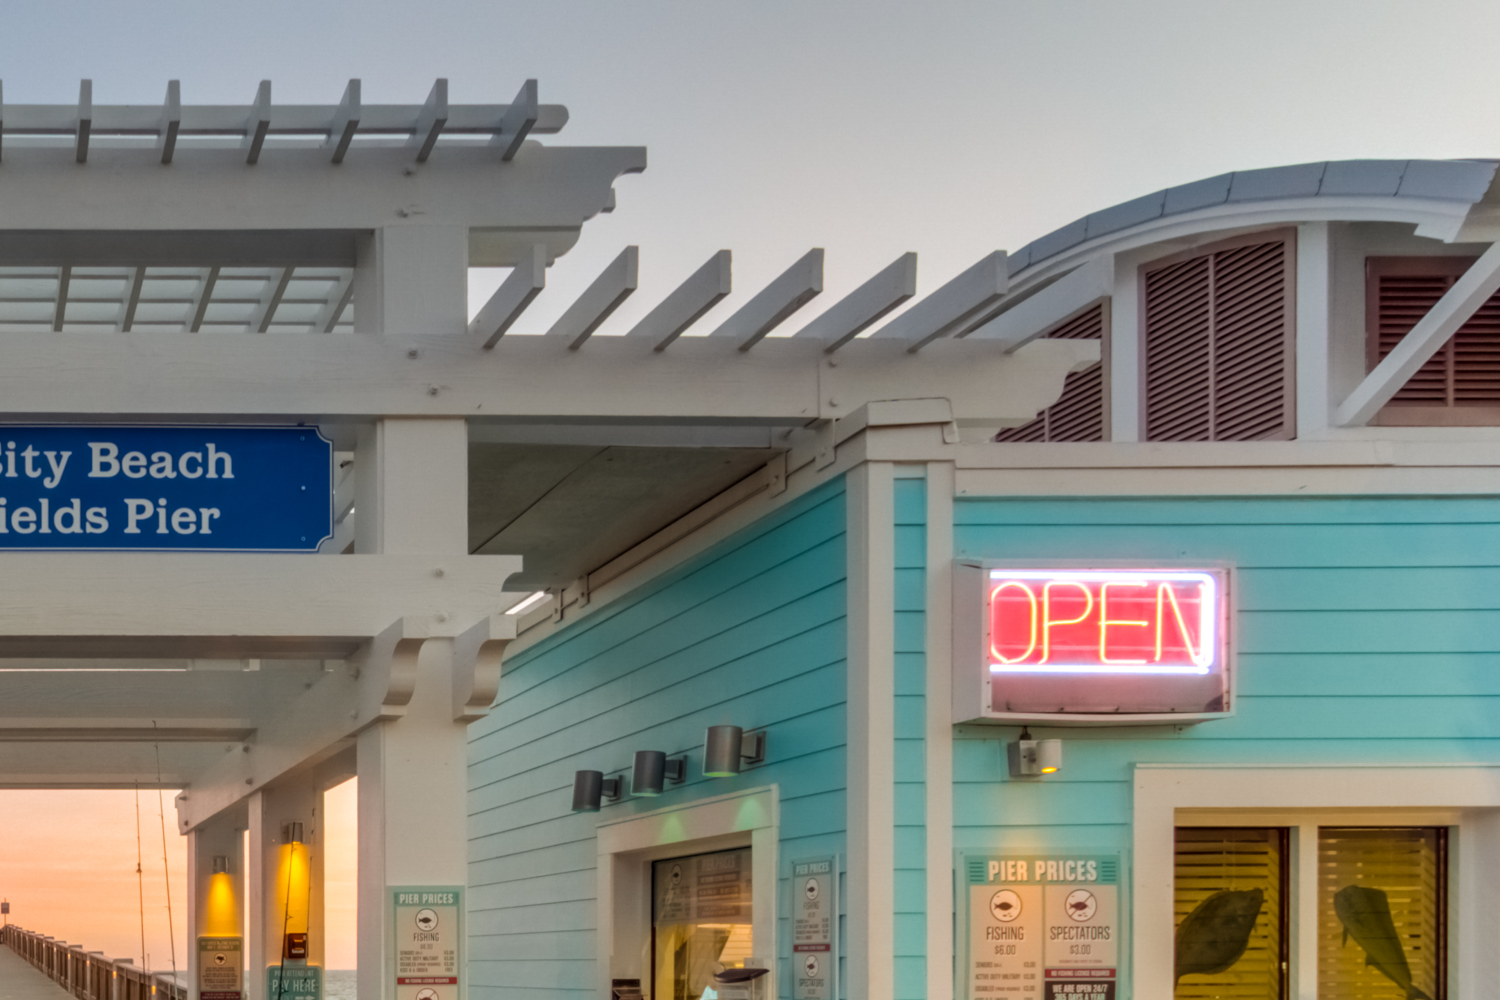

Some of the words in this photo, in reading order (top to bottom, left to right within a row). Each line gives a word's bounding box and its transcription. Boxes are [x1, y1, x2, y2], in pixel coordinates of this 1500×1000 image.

[88, 443, 235, 479] Beach
[124, 499, 221, 535] Pier
[990, 581, 1208, 666] OPEN
[796, 864, 808, 874] PIER
[810, 862, 829, 873] PRICES
[988, 860, 1028, 882] PIER
[1035, 860, 1097, 881] PRICES
[400, 894, 419, 904] PIER
[423, 894, 453, 904] PRICES
[414, 933, 439, 941] FISHING
[986, 926, 1024, 940] FISHING
[1050, 926, 1110, 940] SPECTATORS
[995, 945, 1016, 955] $6.00
[1070, 945, 1090, 955] $3.00
[293, 980, 316, 992] HERE
[1052, 984, 1063, 993] WE
[1064, 984, 1075, 993] ARE
[1076, 984, 1092, 993] OPEN
[1092, 984, 1108, 993] 24/7
